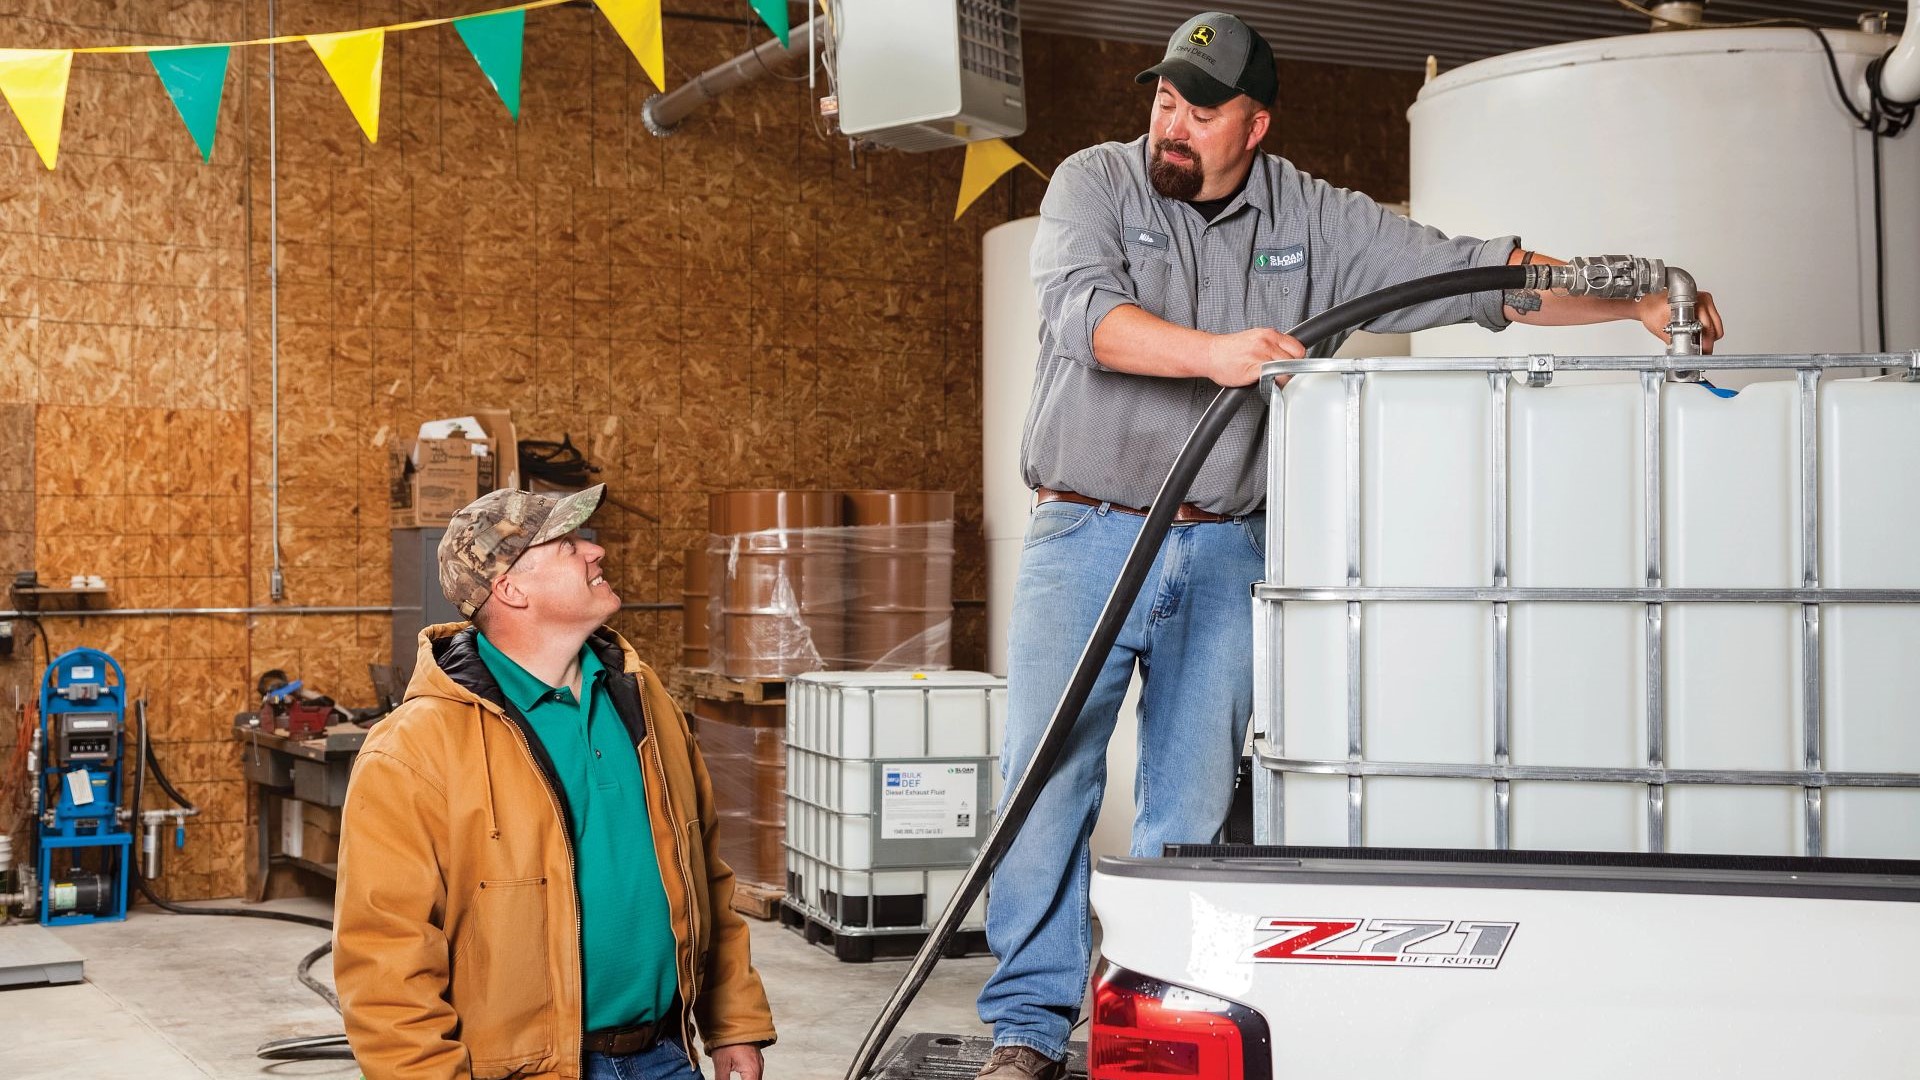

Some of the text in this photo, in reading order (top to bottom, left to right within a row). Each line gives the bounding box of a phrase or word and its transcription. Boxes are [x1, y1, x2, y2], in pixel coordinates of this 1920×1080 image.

[1190, 48, 1217, 66] DEERE
[1138, 232, 1154, 243] Mike
[1269, 250, 1303, 263] SLOAN
[901, 779, 921, 788] DEF
[1253, 919, 1516, 963] Z71
[1400, 955, 1496, 966] OFF ROAD
